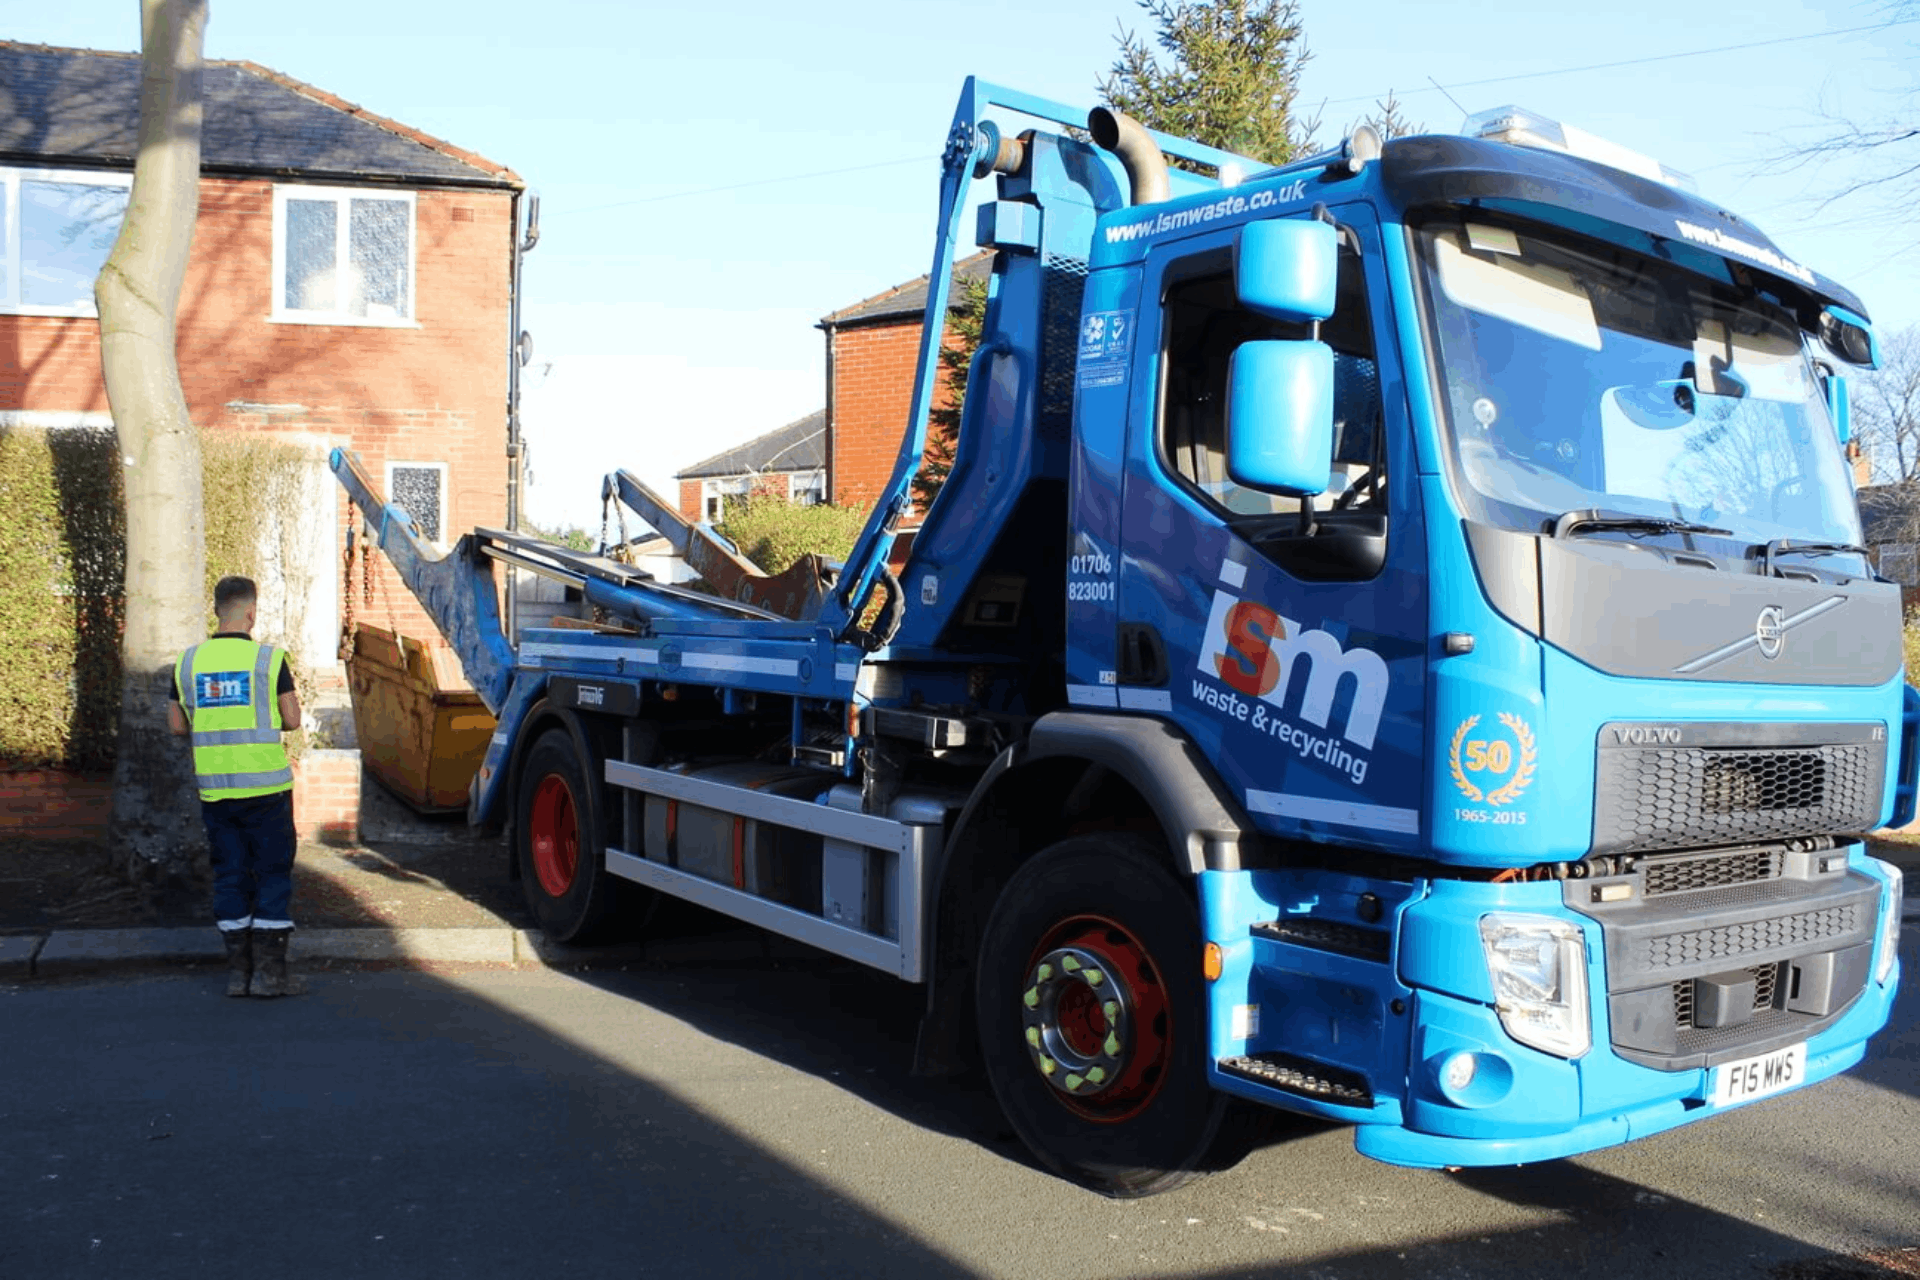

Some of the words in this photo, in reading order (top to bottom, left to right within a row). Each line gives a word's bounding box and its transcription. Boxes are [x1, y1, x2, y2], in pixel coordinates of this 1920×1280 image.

[1105, 179, 1308, 243] www.ismwaste.co.uk
[1072, 554, 1112, 574] 01706
[1069, 581, 1115, 601] 823001
[1197, 558, 1390, 751] ism
[204, 676, 241, 697] ism
[1192, 679, 1250, 721] waste
[1251, 705, 1270, 732] &
[1270, 718, 1368, 785] recycling
[1613, 727, 1682, 744] VOLVO
[1465, 740, 1511, 774] 50
[1454, 808, 1527, 825] 1965-2015
[1728, 1062, 1759, 1098] F15
[1763, 1052, 1794, 1089] MWS
